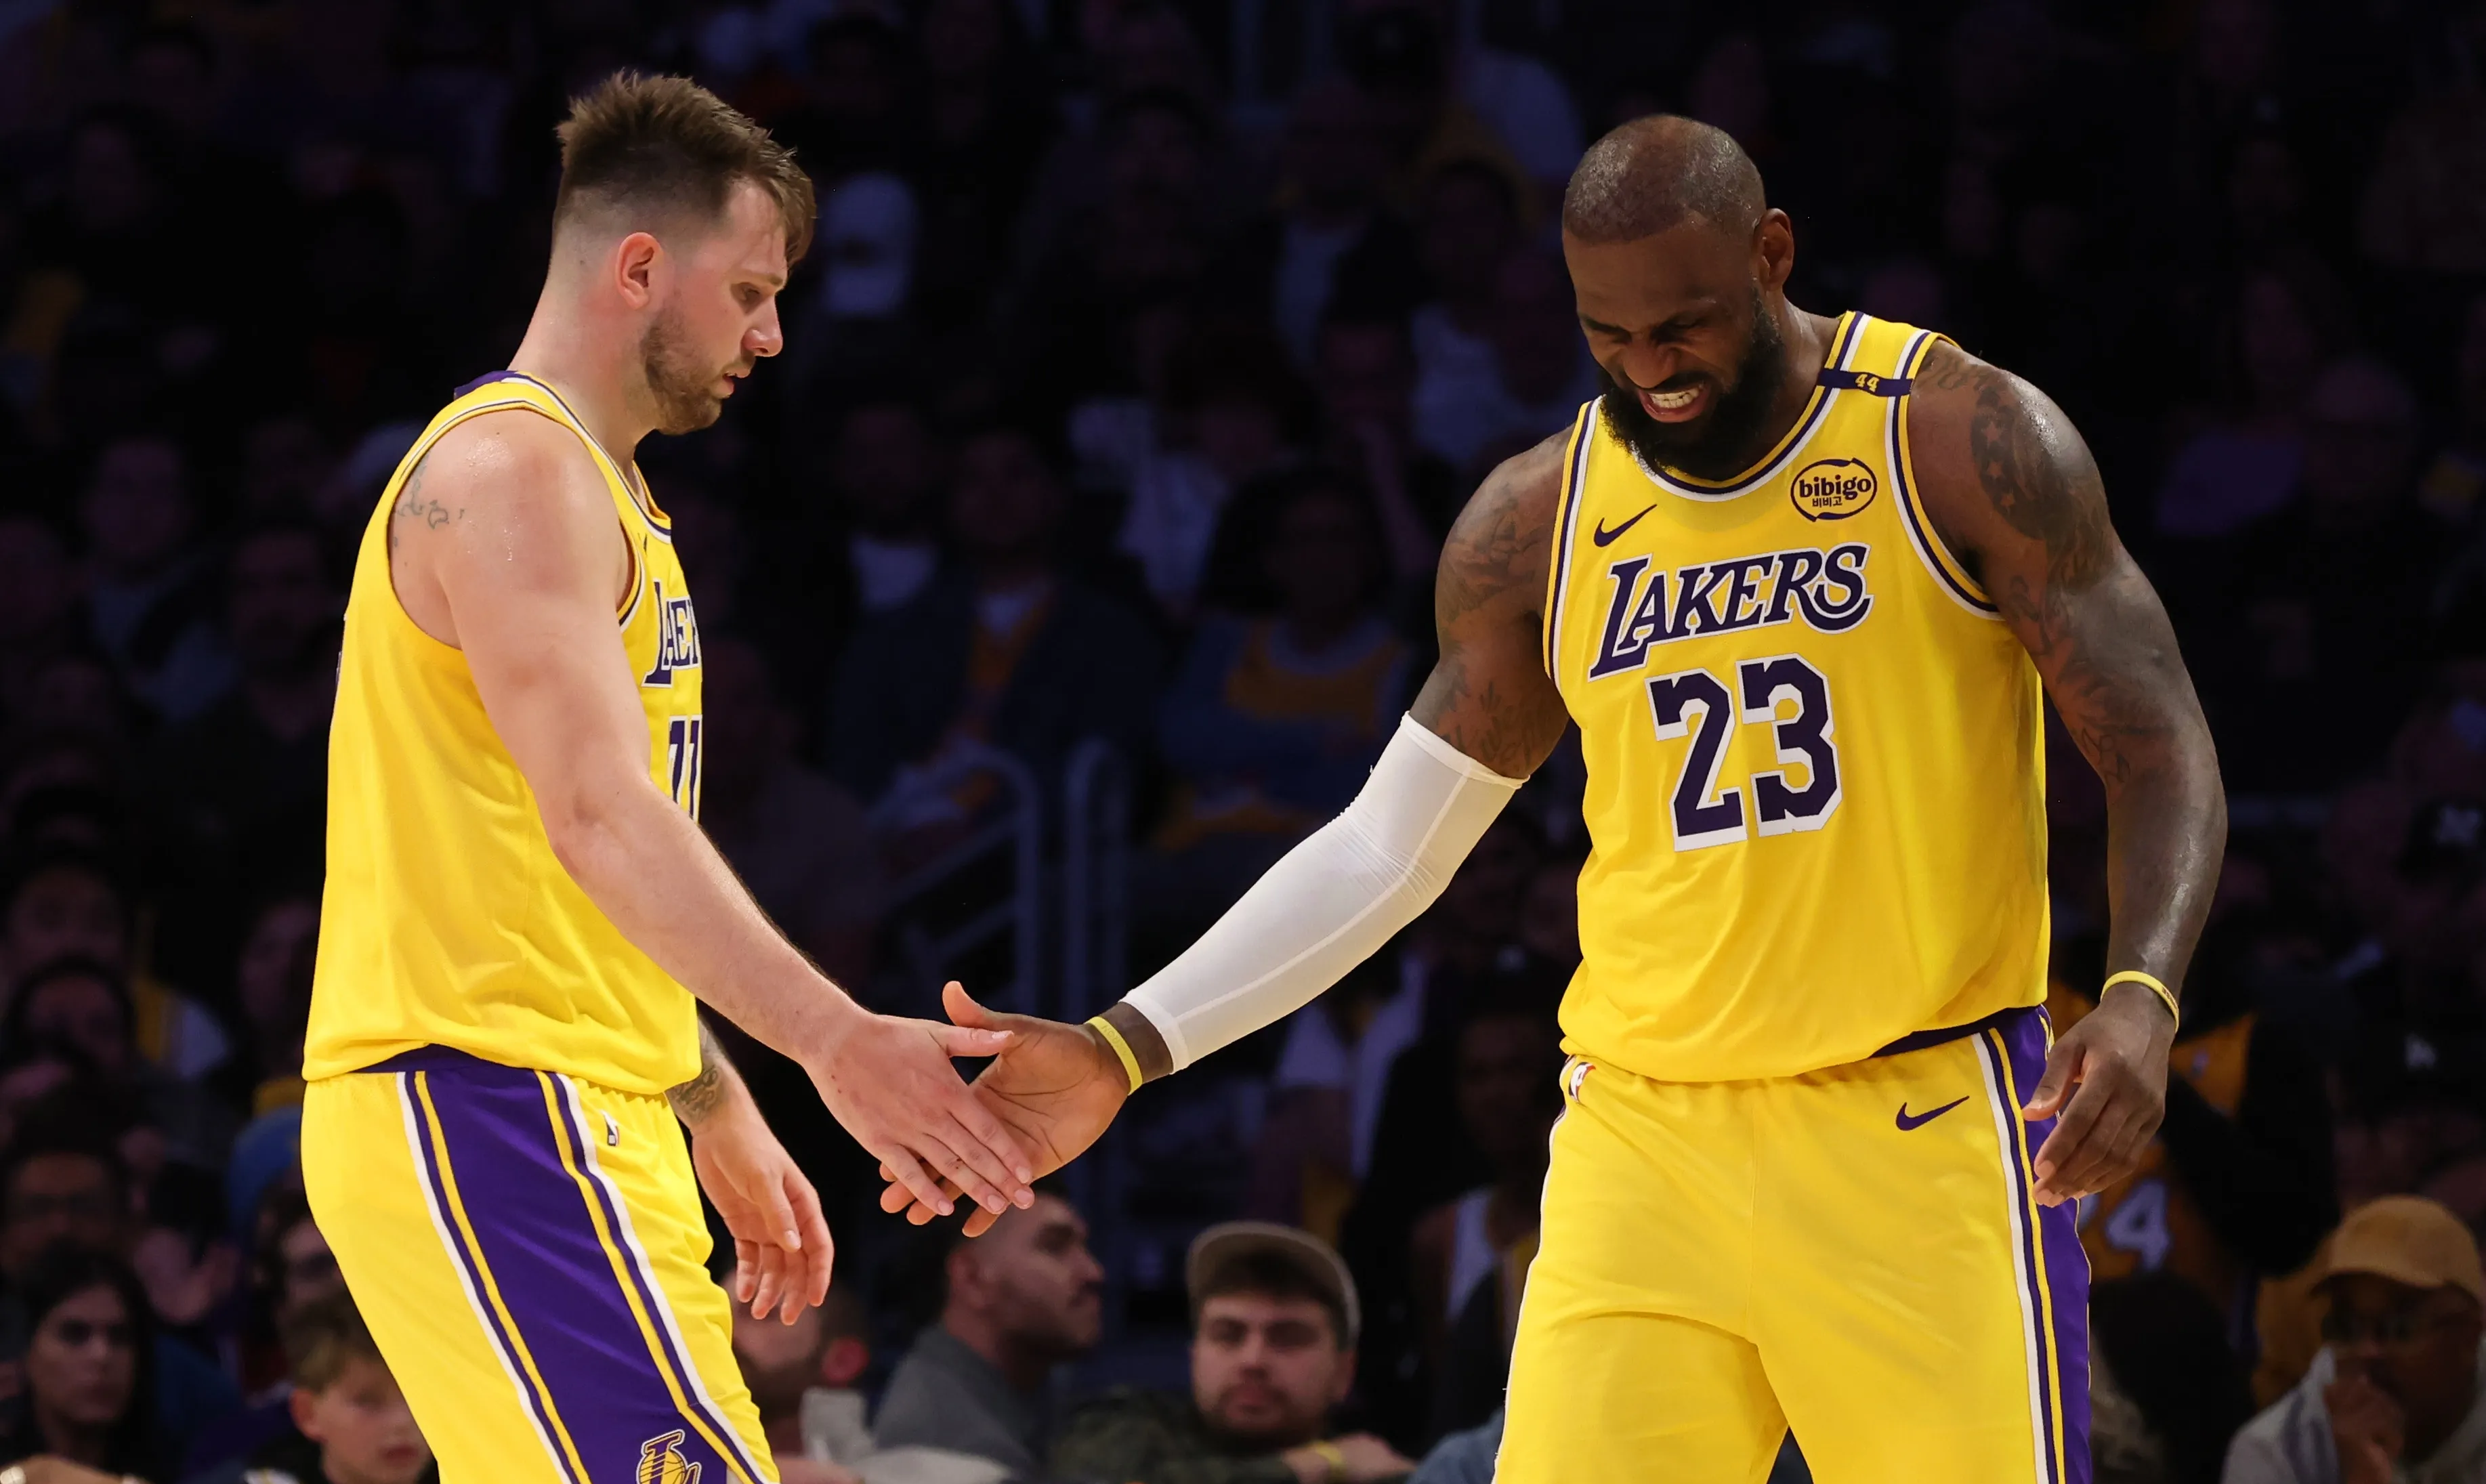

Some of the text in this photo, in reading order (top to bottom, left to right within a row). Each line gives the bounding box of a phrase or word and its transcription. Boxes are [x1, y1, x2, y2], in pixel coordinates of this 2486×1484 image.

[1855, 373, 1880, 392] 44
[1799, 474, 1872, 500] bibigo
[1812, 496, 1842, 508] 비비고
[1588, 542, 1874, 682] LAKERS
[1644, 652, 1844, 852] 23
[2076, 1178, 2170, 1271] 4
